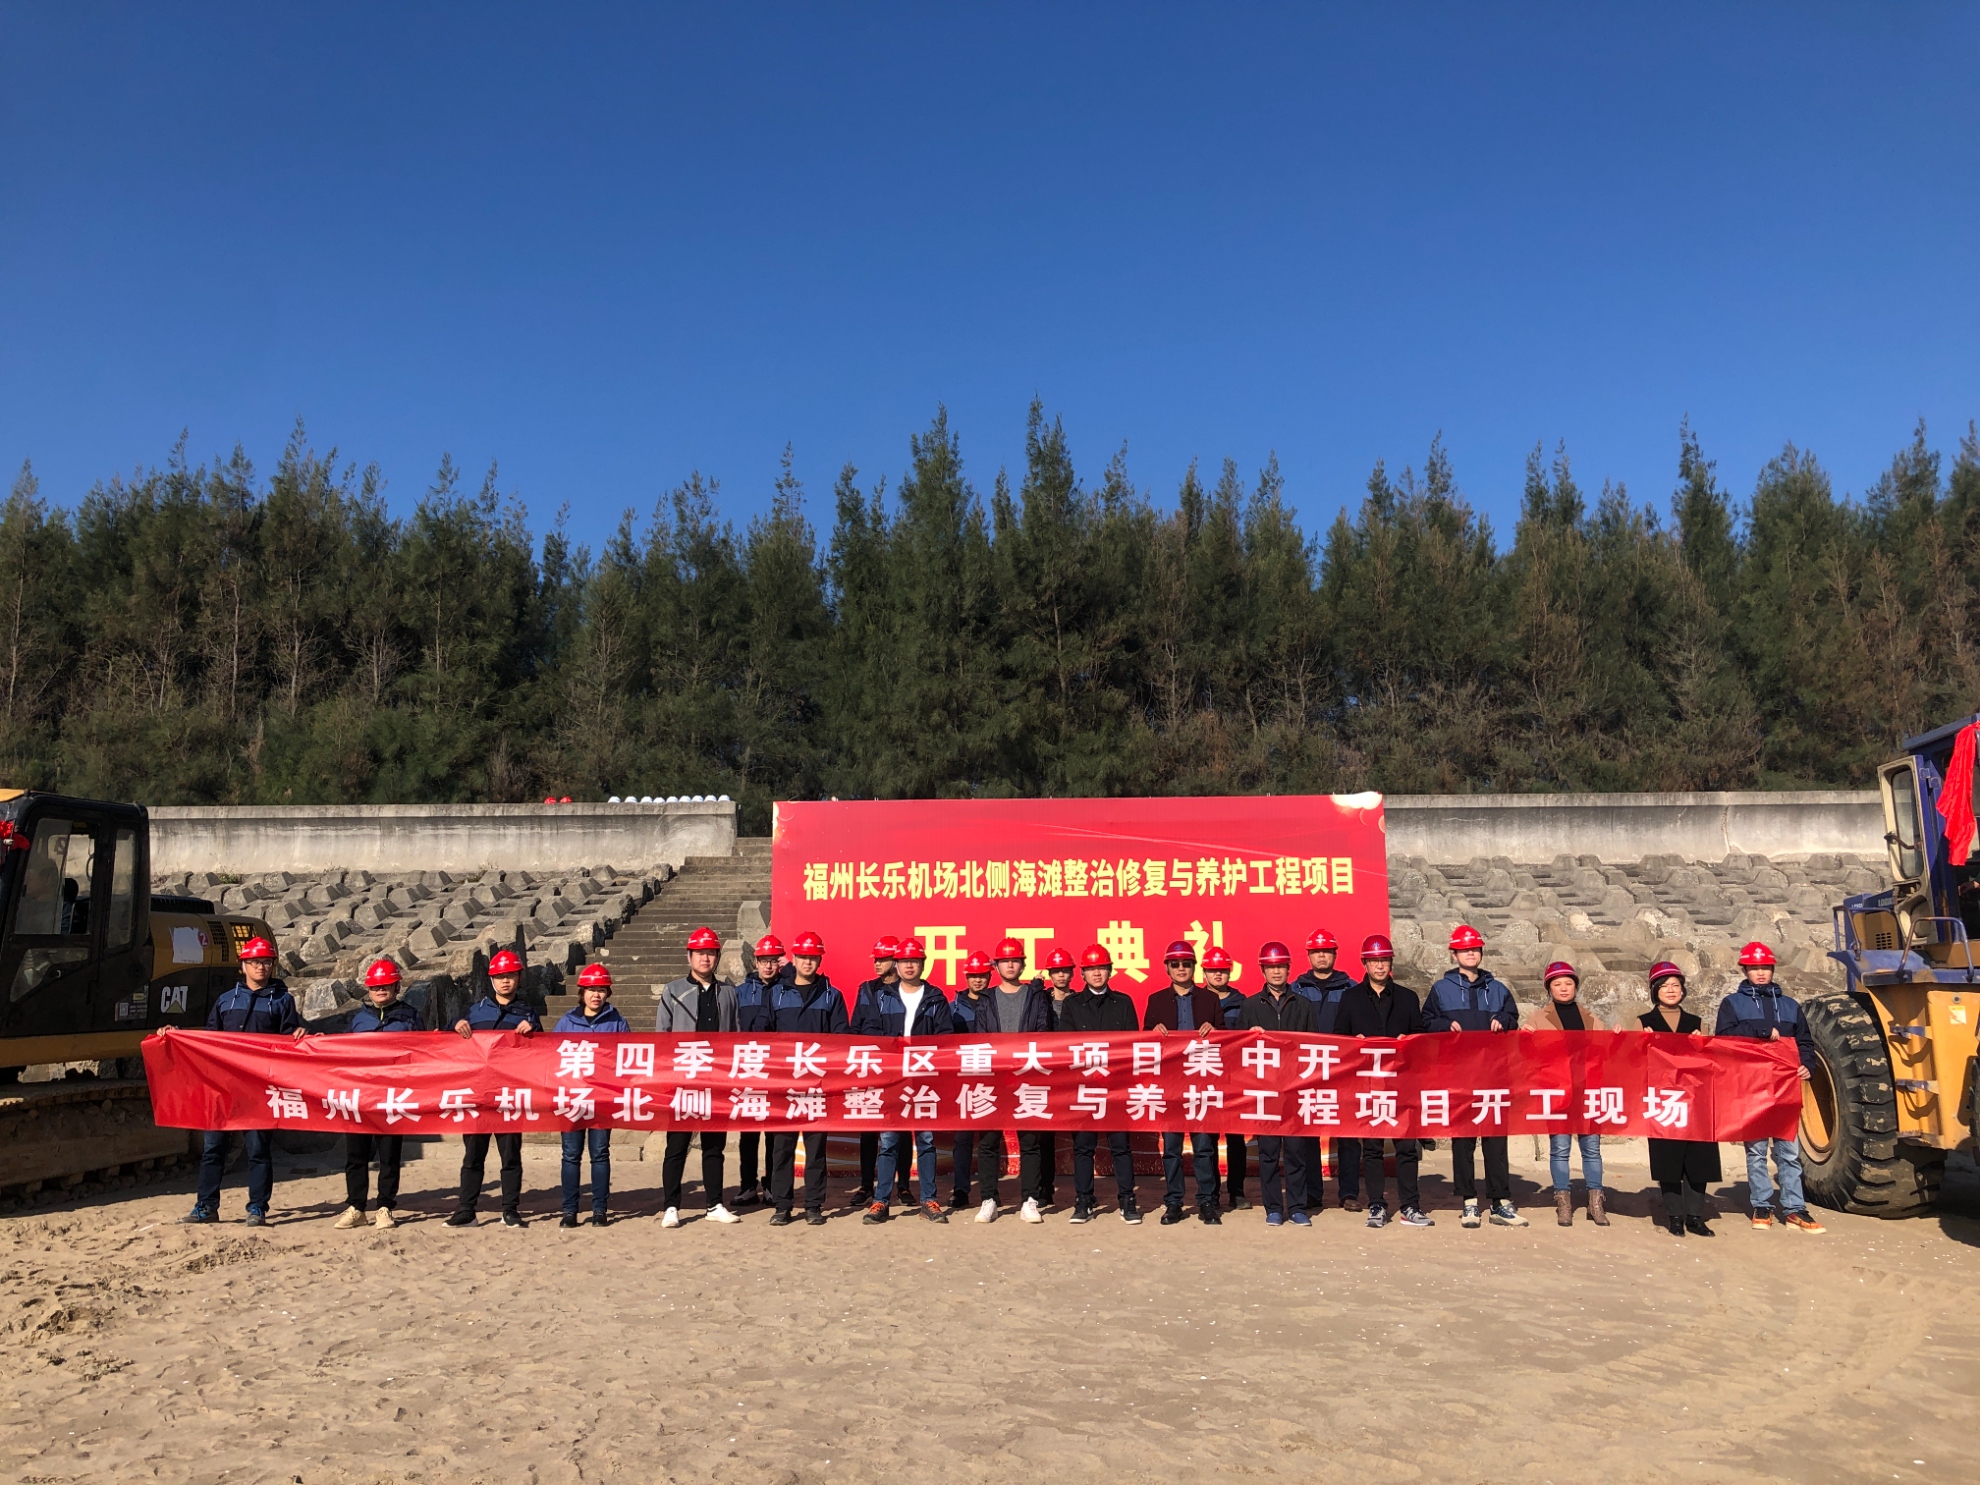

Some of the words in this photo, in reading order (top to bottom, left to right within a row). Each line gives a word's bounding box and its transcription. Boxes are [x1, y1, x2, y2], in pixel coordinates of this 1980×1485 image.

[803, 857, 1354, 901] 福州长乐机场北侧海滩整治修复与养护工程项目
[913, 920, 1242, 986] 开工典礼
[160, 986, 189, 1014] CAT
[556, 1039, 1398, 1081] 第四季度长乐区重大项目集中开工
[265, 1083, 1689, 1128] 福州长乐机场北侧海滩整治修复与养护工程项目开工现场
